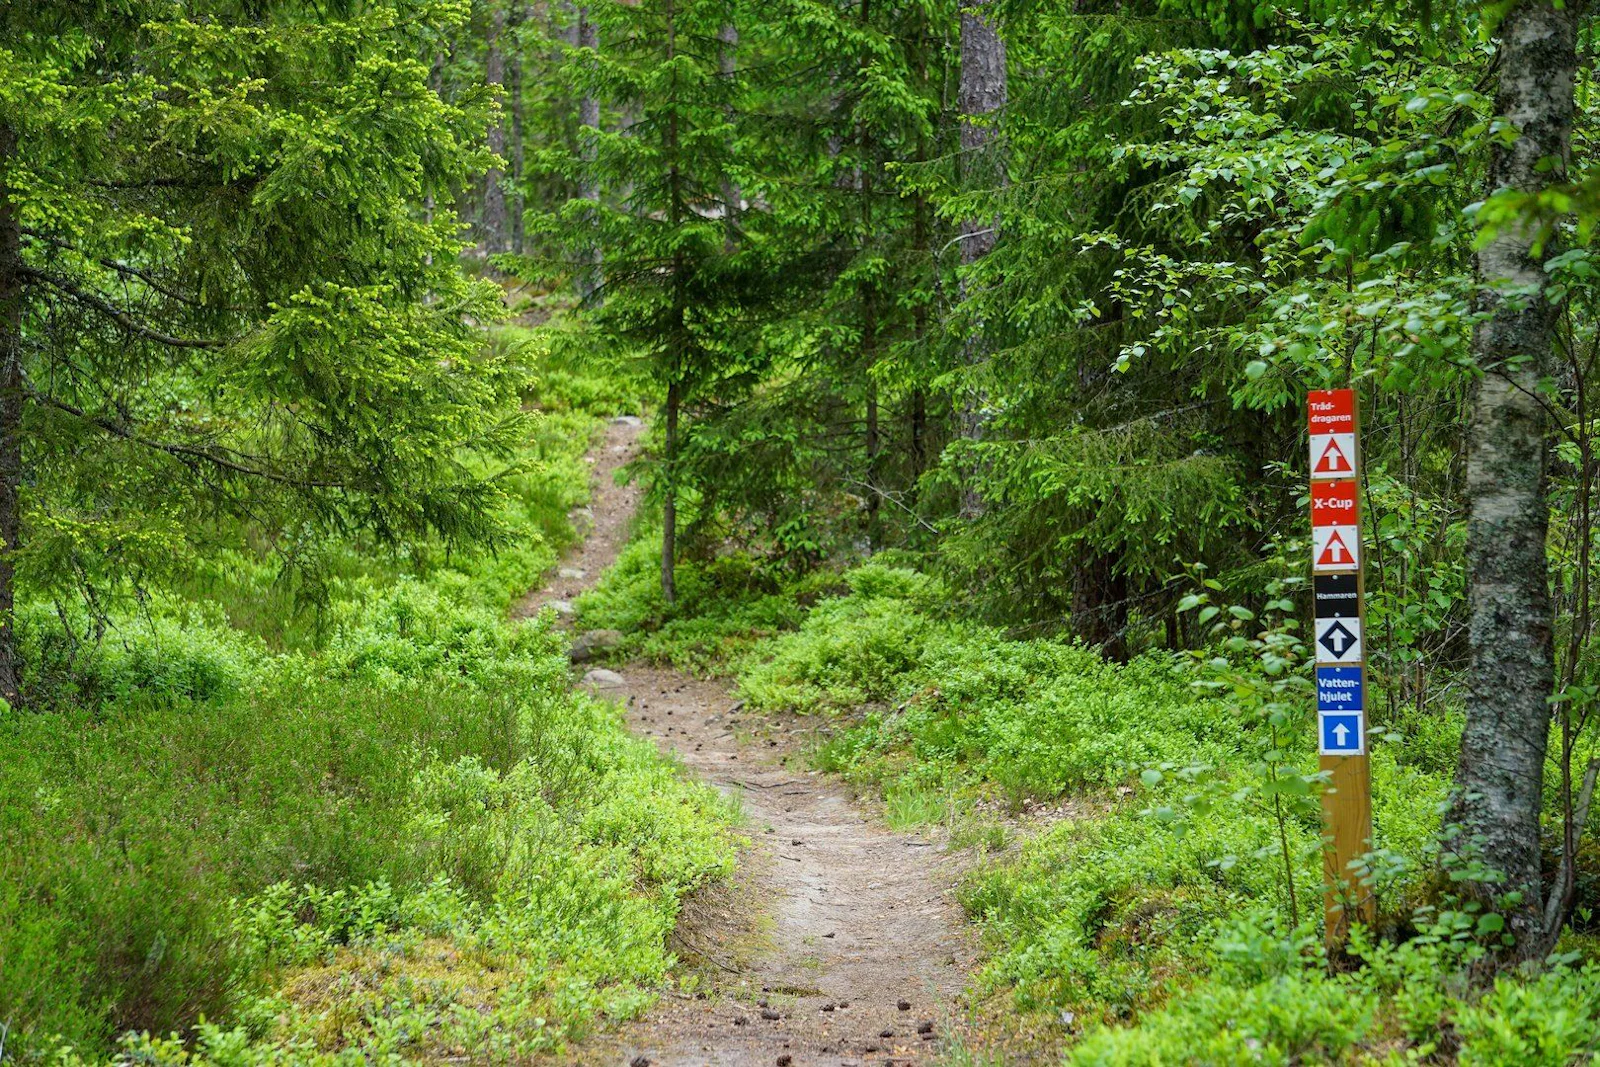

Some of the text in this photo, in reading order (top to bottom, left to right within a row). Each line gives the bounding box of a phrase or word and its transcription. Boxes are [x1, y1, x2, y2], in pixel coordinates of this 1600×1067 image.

[1310, 402, 1335, 411] Tråd-
[1311, 415, 1352, 423] dragaren
[1313, 497, 1353, 510] X-Cup
[1316, 592, 1357, 600] Hammaren
[1318, 678, 1359, 688] Vatten-
[1320, 691, 1352, 703] hjulet
